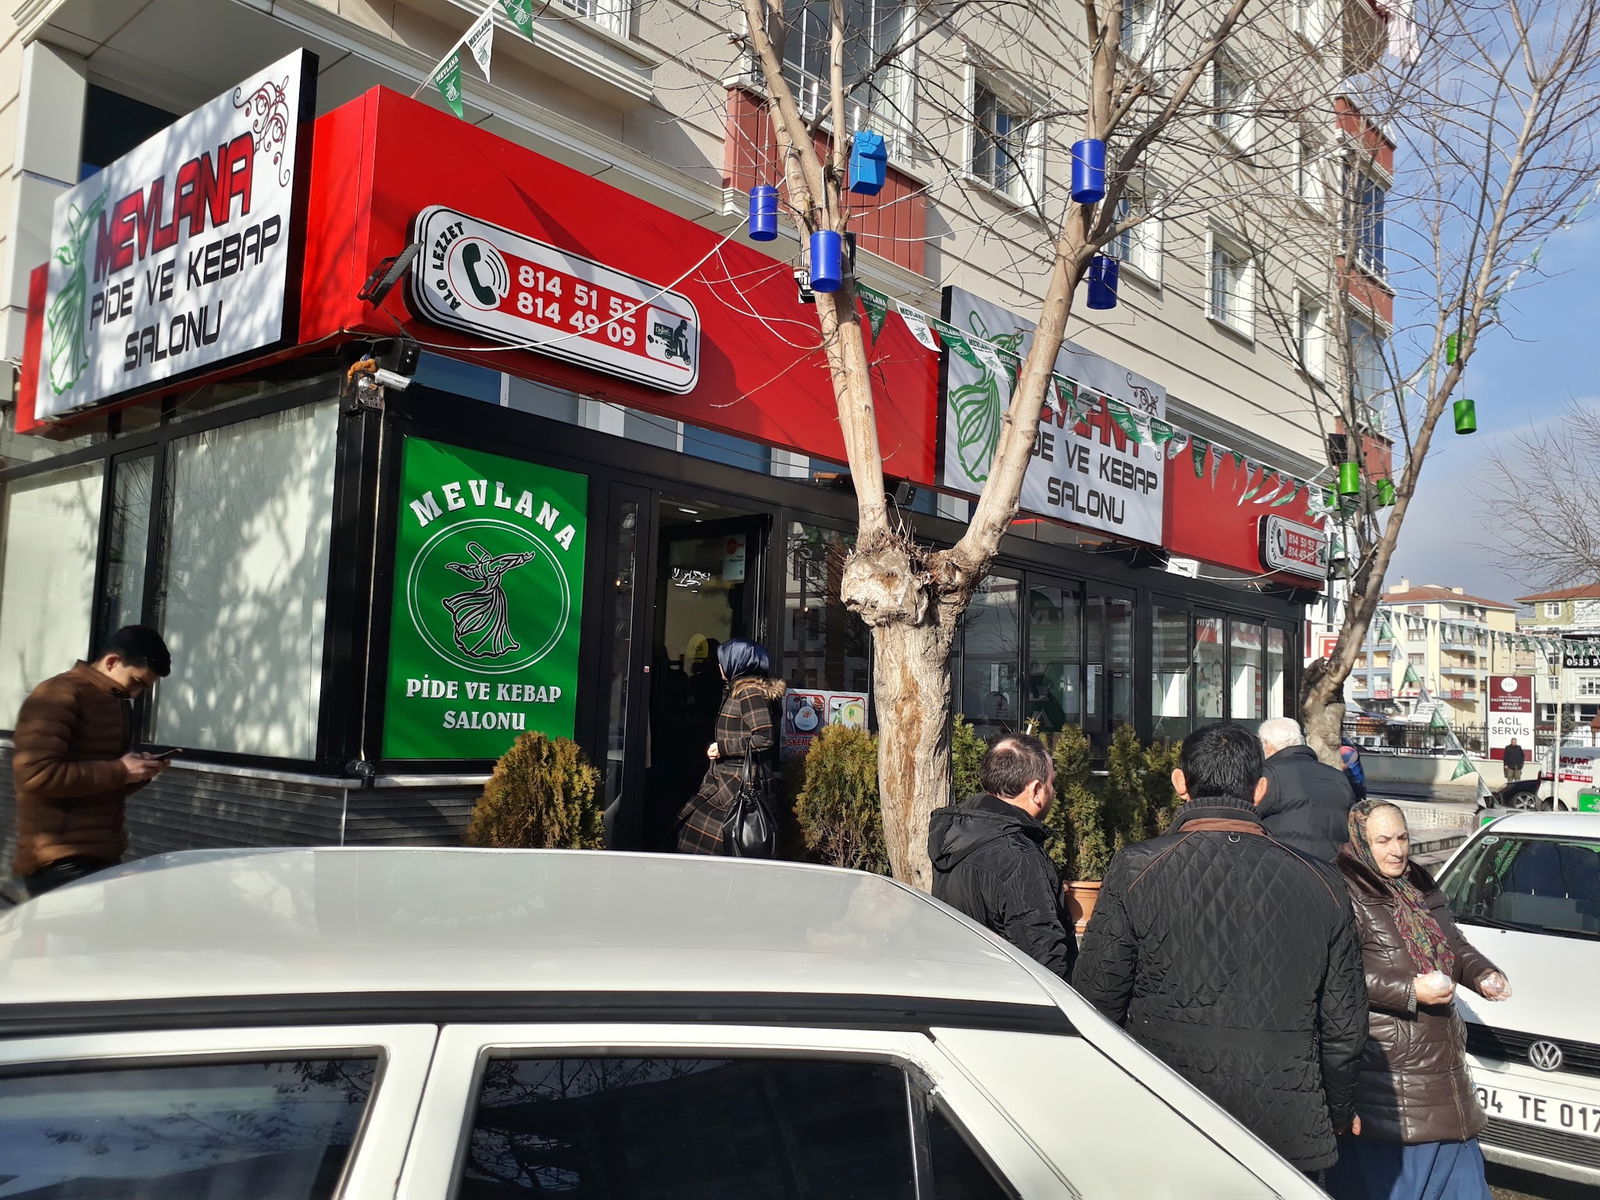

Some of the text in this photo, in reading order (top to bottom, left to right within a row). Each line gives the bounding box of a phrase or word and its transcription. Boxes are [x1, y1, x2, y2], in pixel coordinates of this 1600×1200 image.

[93, 131, 254, 284] MEVLANA
[90, 214, 281, 331] PİDE VE KEBAP
[432, 221, 465, 311] ALO LEZZET
[518, 265, 636, 323] 814 51 52
[123, 300, 223, 373] SALONU
[517, 291, 636, 347] 814 49 09
[1065, 440, 1091, 475] VE
[1099, 452, 1158, 496] KEBAP
[409, 479, 577, 551] MEVLANA
[1047, 476, 1125, 525] SALONU
[1287, 546, 1298, 558] 814
[1288, 533, 1315, 551] 814 51 52
[1566, 658, 1590, 667] 0533
[406, 673, 562, 703] PİDE VE KEBAP
[442, 709, 526, 732] SALONU
[1491, 726, 1530, 736] SERVİS
[1497, 715, 1522, 726] ACİL
[1518, 1095, 1547, 1123] TE
[1560, 1103, 1600, 1133] 017
